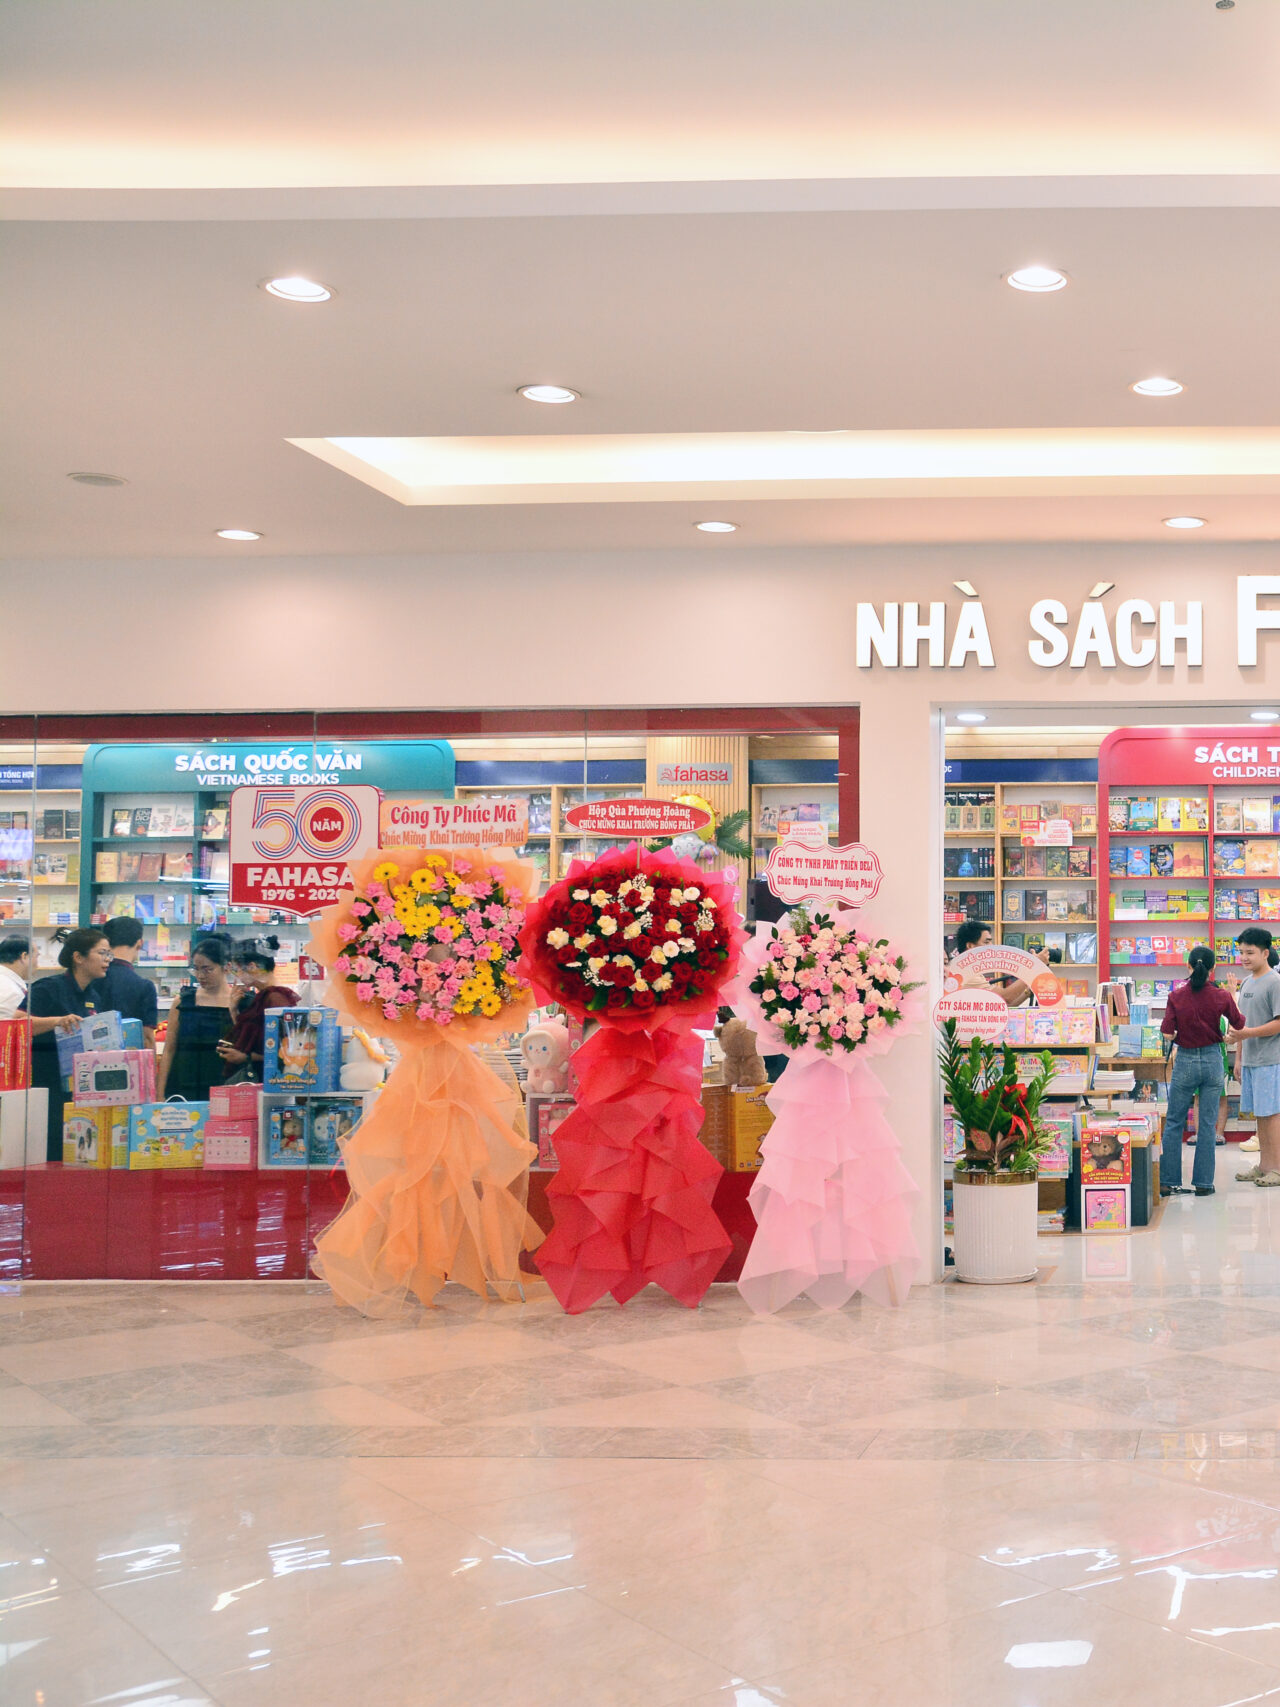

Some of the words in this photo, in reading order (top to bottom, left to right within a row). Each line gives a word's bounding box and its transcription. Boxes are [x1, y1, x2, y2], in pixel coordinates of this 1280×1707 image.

[856, 580, 996, 668] NHÀ
[1028, 581, 1203, 668] SÁCH
[175, 751, 236, 772] SÁCH
[244, 747, 308, 774] QUỐC
[315, 749, 362, 770] VĂN
[1194, 742, 1258, 763] SÁCH
[196, 774, 284, 786] VIETNAMESE
[289, 773, 340, 785] BOOKS
[674, 765, 729, 782] fahasa
[391, 806, 429, 829] Công
[433, 806, 450, 828] Ty
[453, 804, 491, 823] Phúc
[494, 804, 517, 823] Mã
[588, 804, 607, 818] Hộp
[628, 805, 661, 819] Phượng
[663, 804, 691, 818] Hoàng
[252, 789, 362, 861] 50
[312, 818, 342, 831] NĂM
[579, 817, 596, 830] CHÚC
[597, 817, 616, 830] MỪNG
[616, 819, 633, 830] KHAI
[634, 819, 659, 830] TRƯƠNG
[678, 818, 696, 830] PHÁT
[380, 829, 400, 845] Chúc
[430, 829, 450, 845] Khai
[482, 825, 504, 846] Hồng
[505, 826, 524, 843] Phát
[778, 855, 794, 868] CÔNG
[795, 857, 804, 868] TY
[805, 858, 821, 869] TNHH
[822, 857, 839, 869] PHÁT
[840, 855, 858, 871] TRIỂN
[859, 860, 873, 871] DELI
[246, 866, 354, 887] FAHASA
[777, 875, 791, 886] Chúc
[810, 876, 823, 887] Khai
[261, 889, 295, 901] 1976
[957, 952, 976, 970] THẾ
[975, 949, 995, 961] GIỚI
[996, 949, 1034, 969] STICKER
[972, 960, 994, 973] DÁN
[994, 959, 1018, 973] HÌNH
[939, 1001, 952, 1011] CTY
[953, 1000, 971, 1011] SÁCH
[973, 1002, 983, 1011] MC
[985, 1002, 1005, 1012] BOOKS
